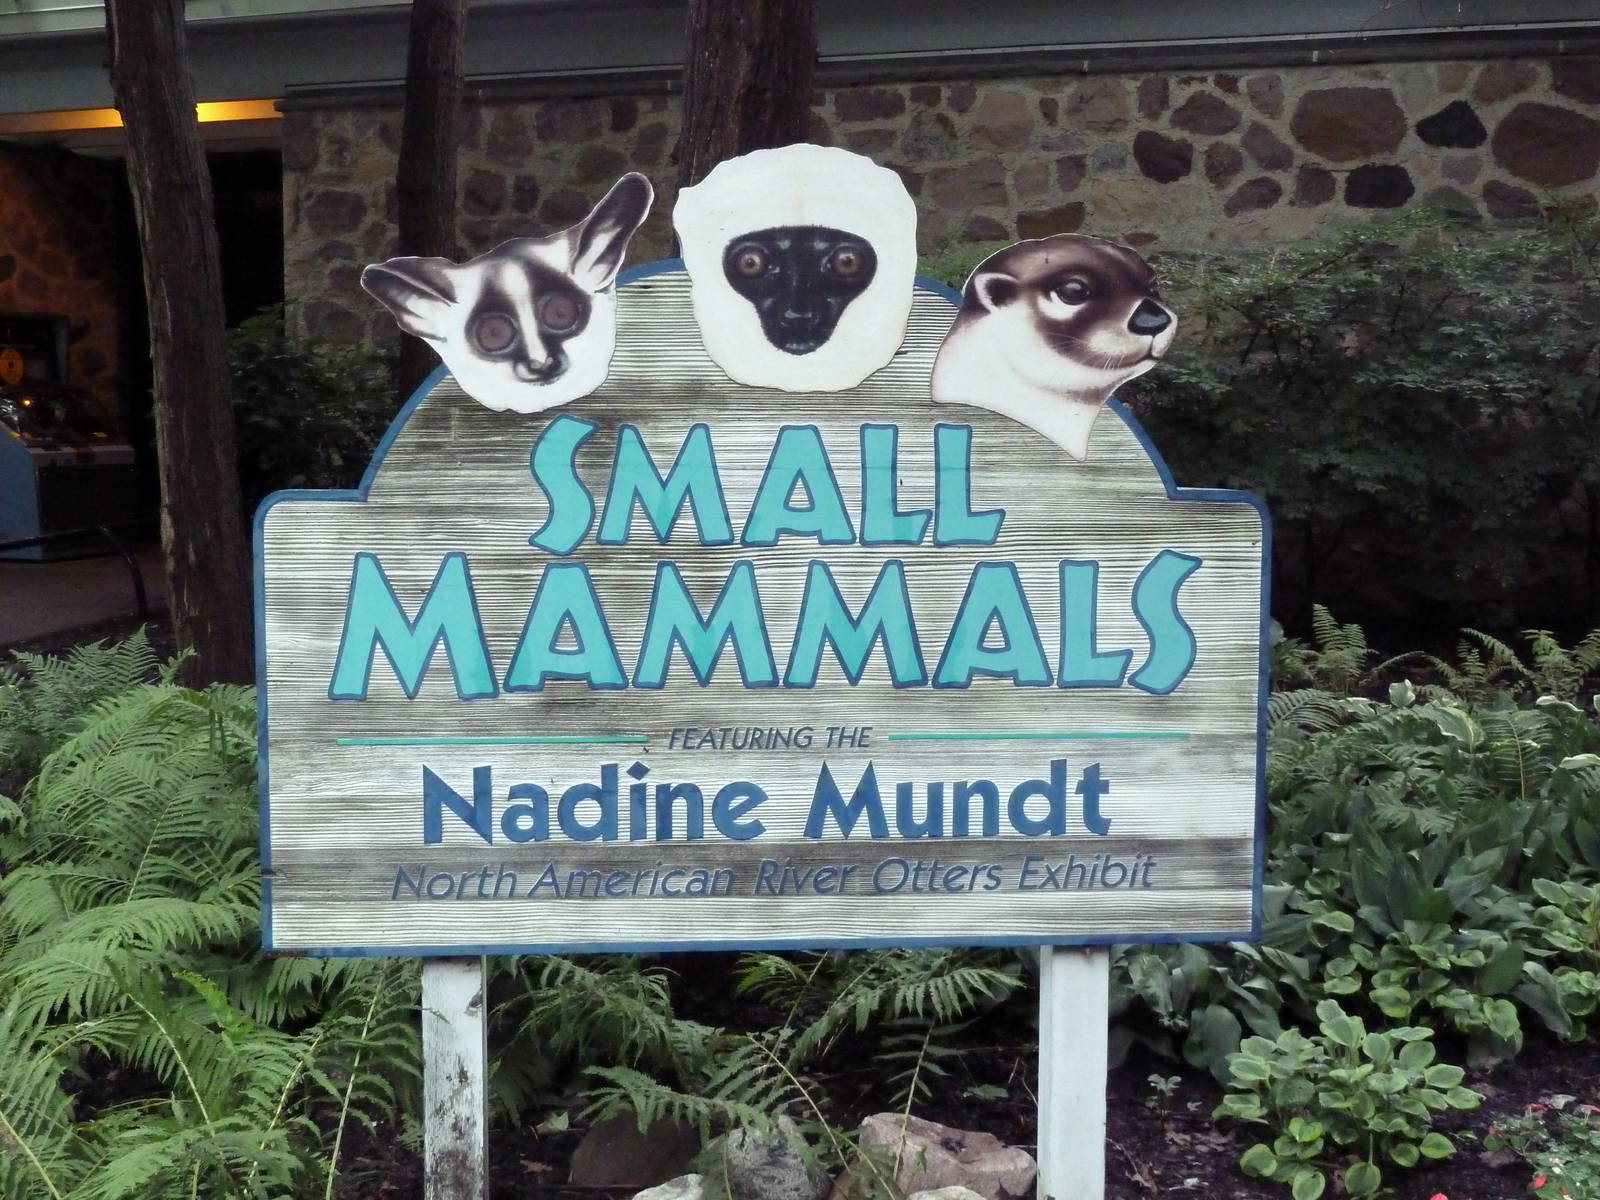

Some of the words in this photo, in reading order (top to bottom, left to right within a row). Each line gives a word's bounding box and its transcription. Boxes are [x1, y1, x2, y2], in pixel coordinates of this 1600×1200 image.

[528, 413, 1006, 556] SMALL
[328, 549, 1203, 700] MAMMALS
[668, 726, 814, 750] FEATURING
[825, 726, 873, 748] THE
[422, 760, 769, 846] Nadine
[803, 759, 1112, 840] Mundt
[391, 862, 517, 900] North
[527, 861, 736, 899] American
[754, 856, 857, 895] River
[872, 856, 1002, 893] Otters
[1017, 851, 1157, 890] Exhibit
